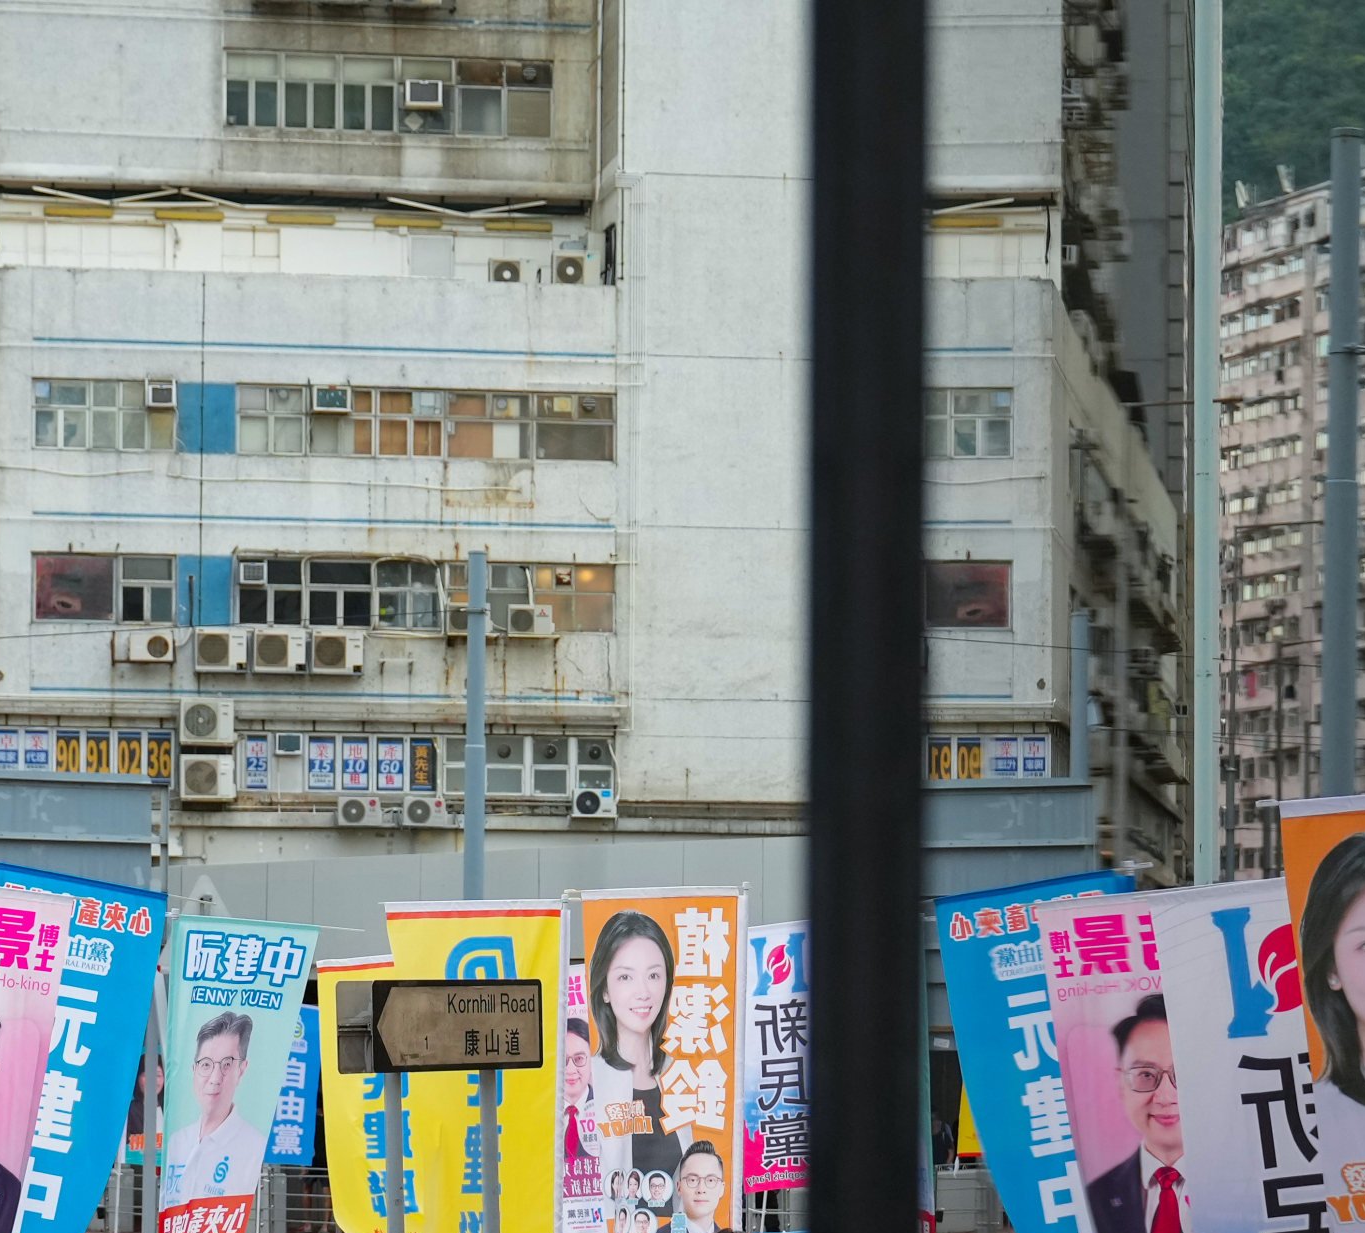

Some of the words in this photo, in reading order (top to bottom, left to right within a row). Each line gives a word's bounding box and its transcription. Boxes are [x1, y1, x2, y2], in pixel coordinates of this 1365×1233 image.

[56, 739, 80, 773] 90
[87, 739, 110, 773] 91
[118, 740, 142, 774] 02
[147, 740, 171, 778] 36
[247, 758, 267, 771] 25
[311, 759, 332, 773] 15
[344, 759, 366, 773] 10
[379, 760, 400, 773] 60
[33, 923, 62, 974] 博士
[186, 932, 305, 986] 阮建中
[240, 991, 283, 1010] YUEN
[446, 992, 496, 1014] Kornhill
[500, 993, 535, 1014] Road
[464, 1028, 522, 1057] 康山道
[272, 1057, 306, 1156] 自由黨
